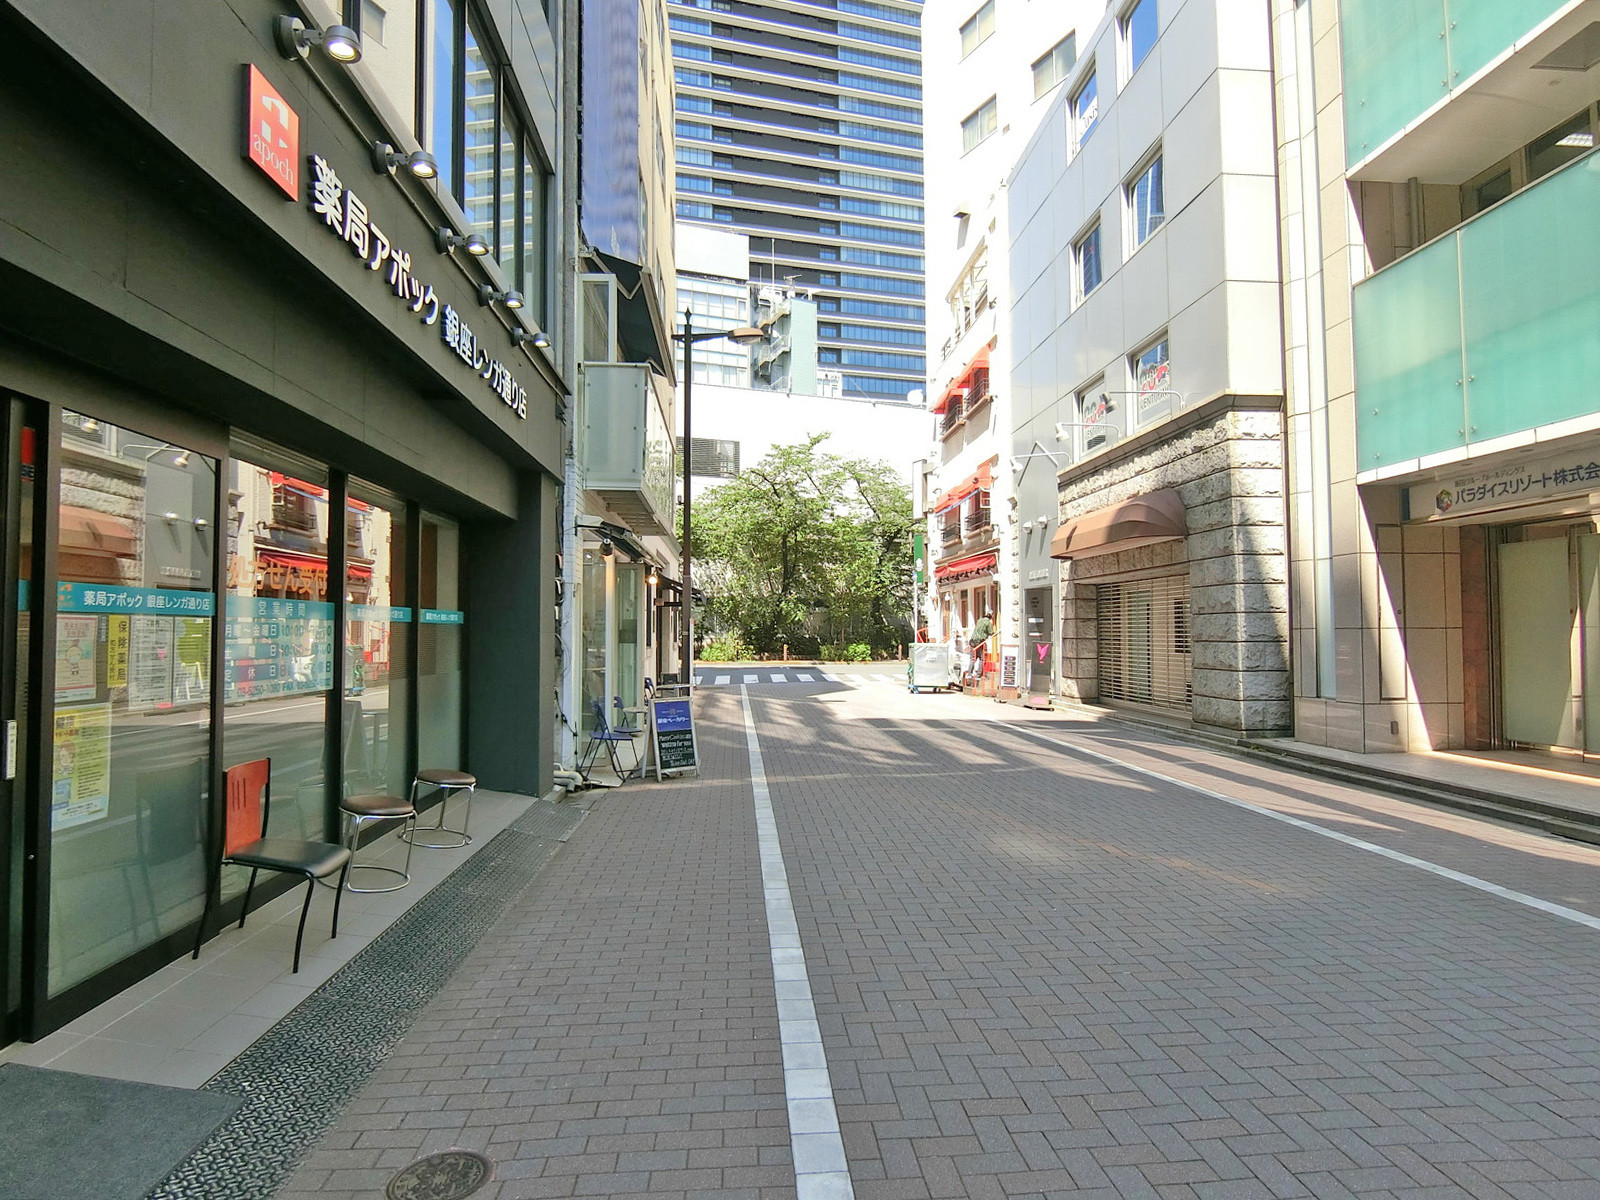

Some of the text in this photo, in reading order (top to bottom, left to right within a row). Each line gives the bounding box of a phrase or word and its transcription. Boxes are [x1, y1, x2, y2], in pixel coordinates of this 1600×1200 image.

[253, 132, 294, 185] apoch
[308, 154, 527, 420] 薬局アポック 銀座レンガ通り店
[1456, 461, 1600, 504] パラダイスリゾート株式会
[227, 552, 328, 595] 処方せん受付
[84, 590, 142, 607] 薬局アポック
[147, 595, 210, 610] 銀座レンガ通り店
